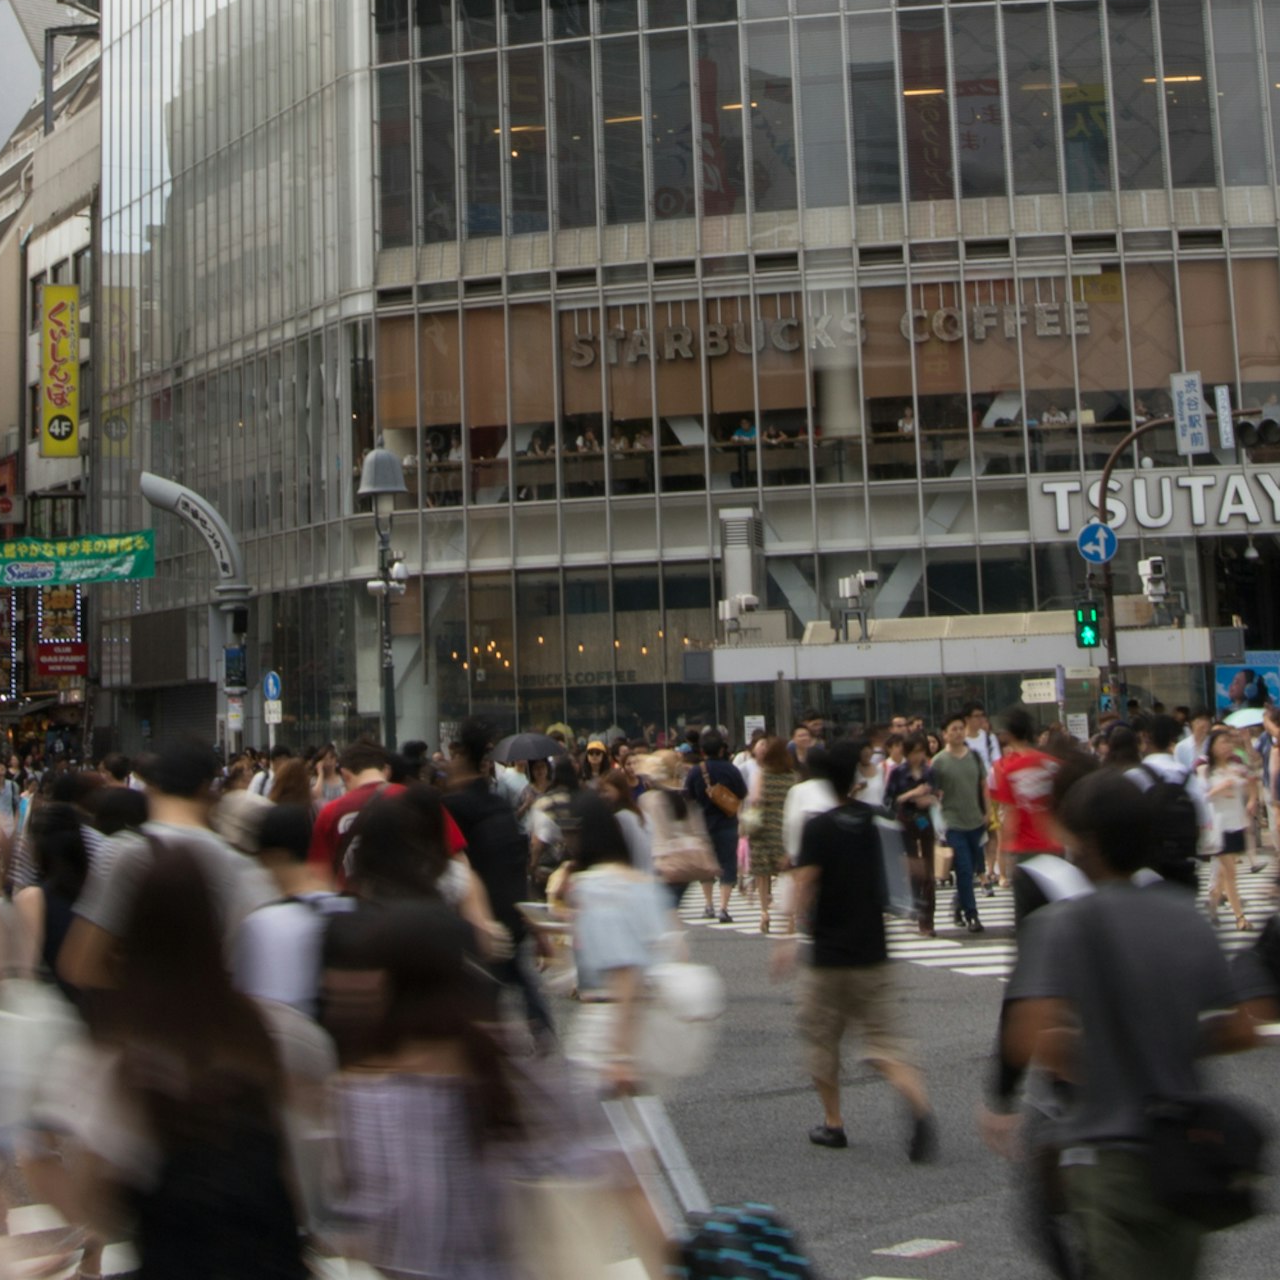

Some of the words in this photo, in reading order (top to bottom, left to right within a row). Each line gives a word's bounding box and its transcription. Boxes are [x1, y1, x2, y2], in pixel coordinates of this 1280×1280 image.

[570, 311, 867, 368] STARBUCKS
[900, 302, 1091, 344] COFFEE
[48, 418, 71, 437] 4F
[1184, 378, 1206, 447] 渋谷駅前
